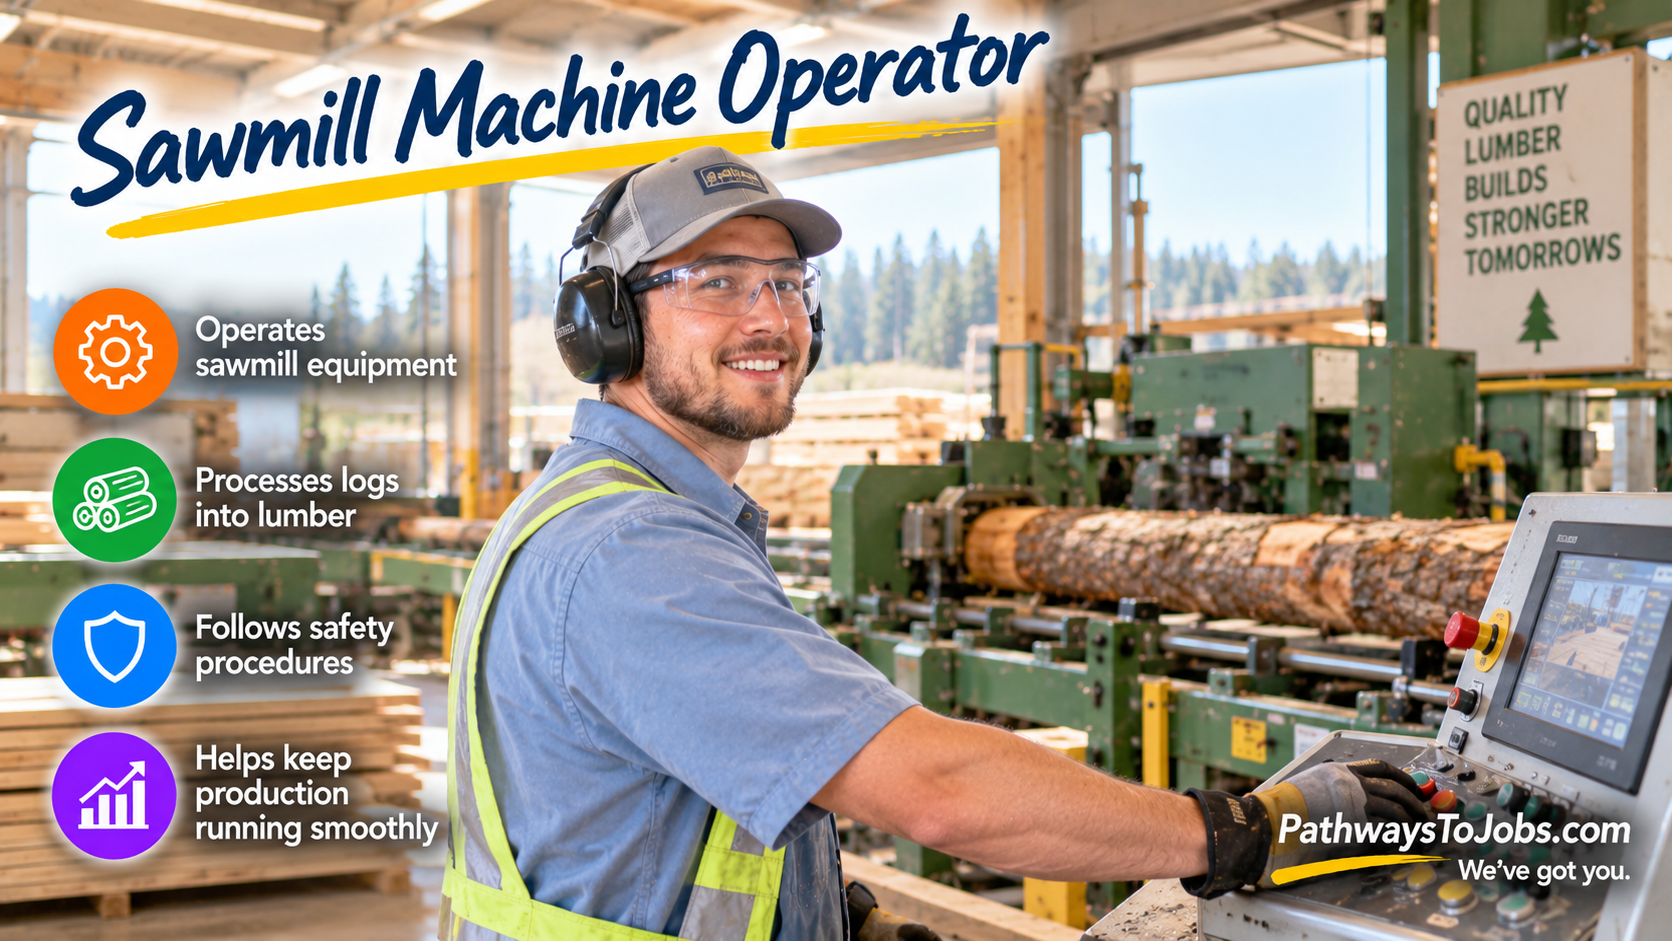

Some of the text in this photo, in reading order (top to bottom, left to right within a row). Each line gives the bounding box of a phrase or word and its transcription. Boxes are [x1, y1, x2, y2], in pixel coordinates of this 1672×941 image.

[1465, 83, 1568, 128] QUALITY
[1465, 124, 1561, 165] LUMBER
[1465, 164, 1548, 202] BUILDS
[1465, 198, 1589, 239] STRONGER
[1464, 233, 1622, 276] TOMORROWS
